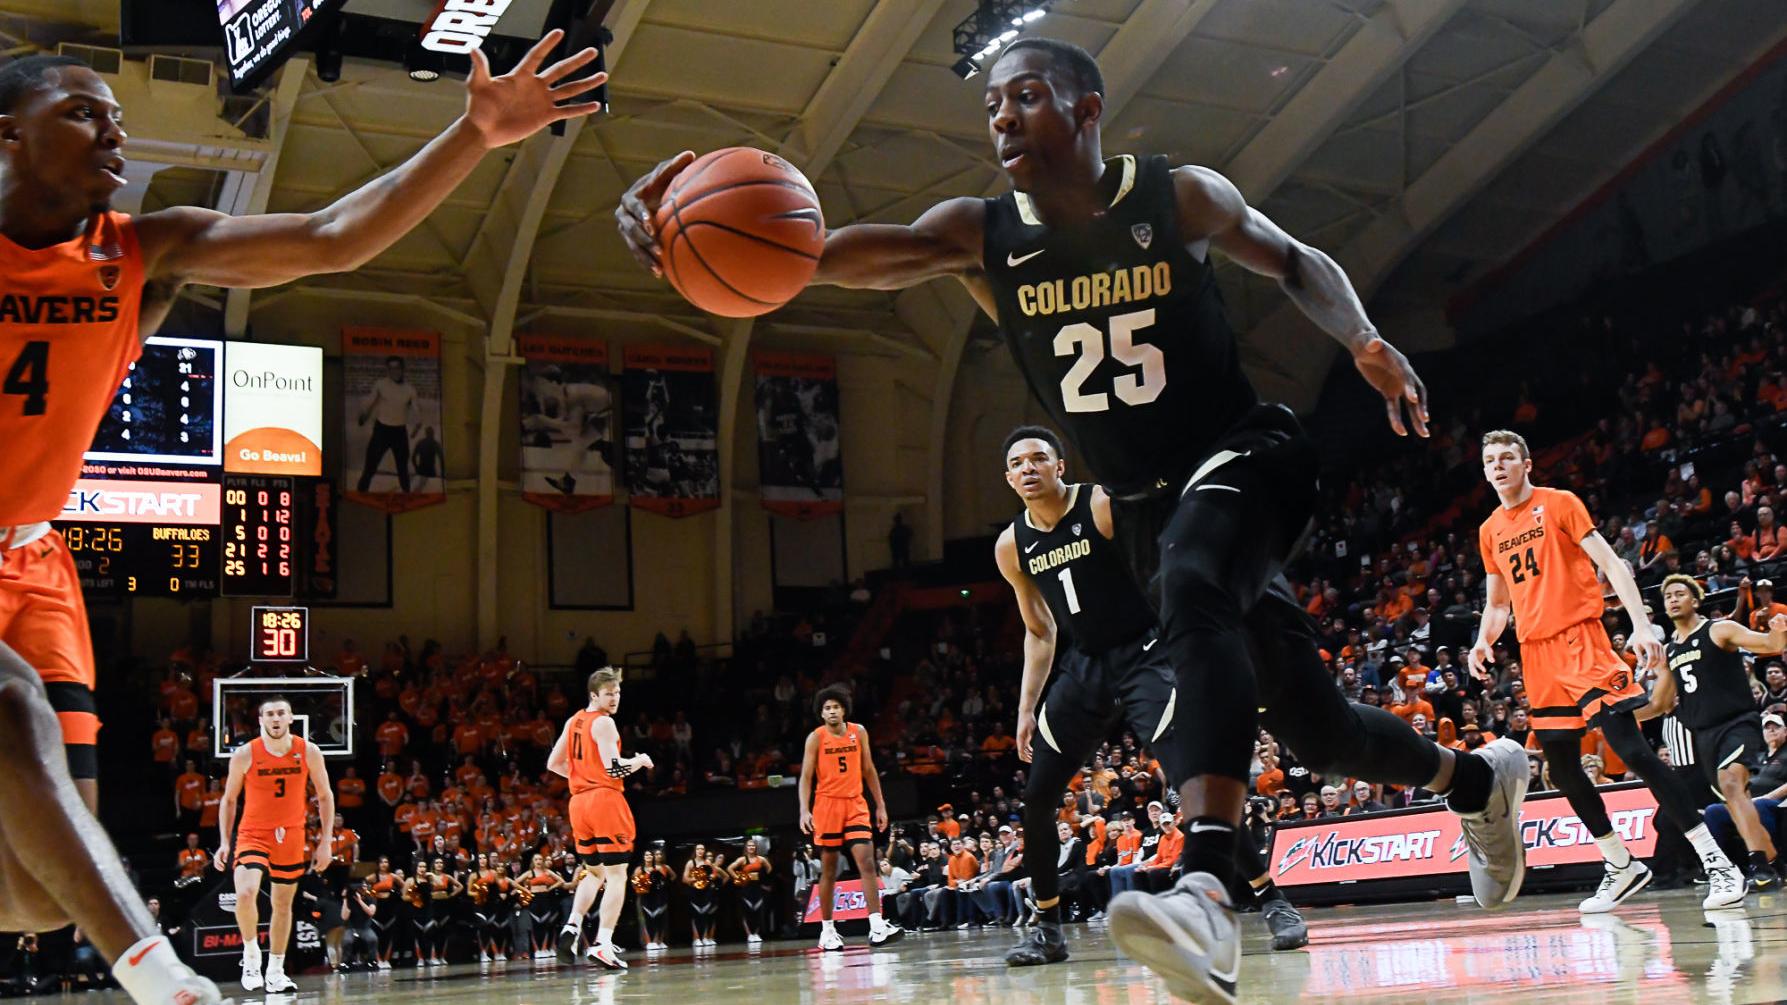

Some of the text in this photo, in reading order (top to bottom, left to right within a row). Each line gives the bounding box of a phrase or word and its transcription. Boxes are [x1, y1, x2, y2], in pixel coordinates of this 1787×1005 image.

[1017, 261, 1172, 317] COLORADO
[1053, 308, 1167, 413] 25
[3, 341, 50, 416] 4
[180, 380, 190, 392] 4
[233, 369, 312, 392] OnPoint
[179, 413, 189, 425] 4
[121, 428, 131, 440] 4
[239, 448, 307, 463] Go Beavs!
[107, 467, 117, 475] or
[117, 466, 137, 476] visit
[226, 490, 291, 507] 00 0 8
[240, 509, 290, 524] 1 1 12
[152, 527, 210, 541] BUFFALOES
[235, 525, 290, 542] 5 0 0
[1498, 526, 1545, 553] BEAVERS
[170, 544, 200, 568] 33
[225, 542, 290, 559] 21 2 2
[1028, 538, 1091, 575] COLORADO
[99, 556, 110, 574] 2
[225, 560, 290, 577] 25 1 6
[1509, 547, 1541, 584] 24
[128, 576, 137, 591] 3
[170, 577, 179, 592] 0
[1058, 567, 1081, 614] 1
[263, 612, 301, 629] 18:26
[263, 629, 295, 655] 30
[1679, 664, 1698, 693] 5
[573, 732, 583, 760] 11
[838, 756, 847, 773] 5
[274, 778, 286, 798] 3
[1309, 830, 1441, 869] KICKSTART
[202, 930, 269, 948] BI-MAT
